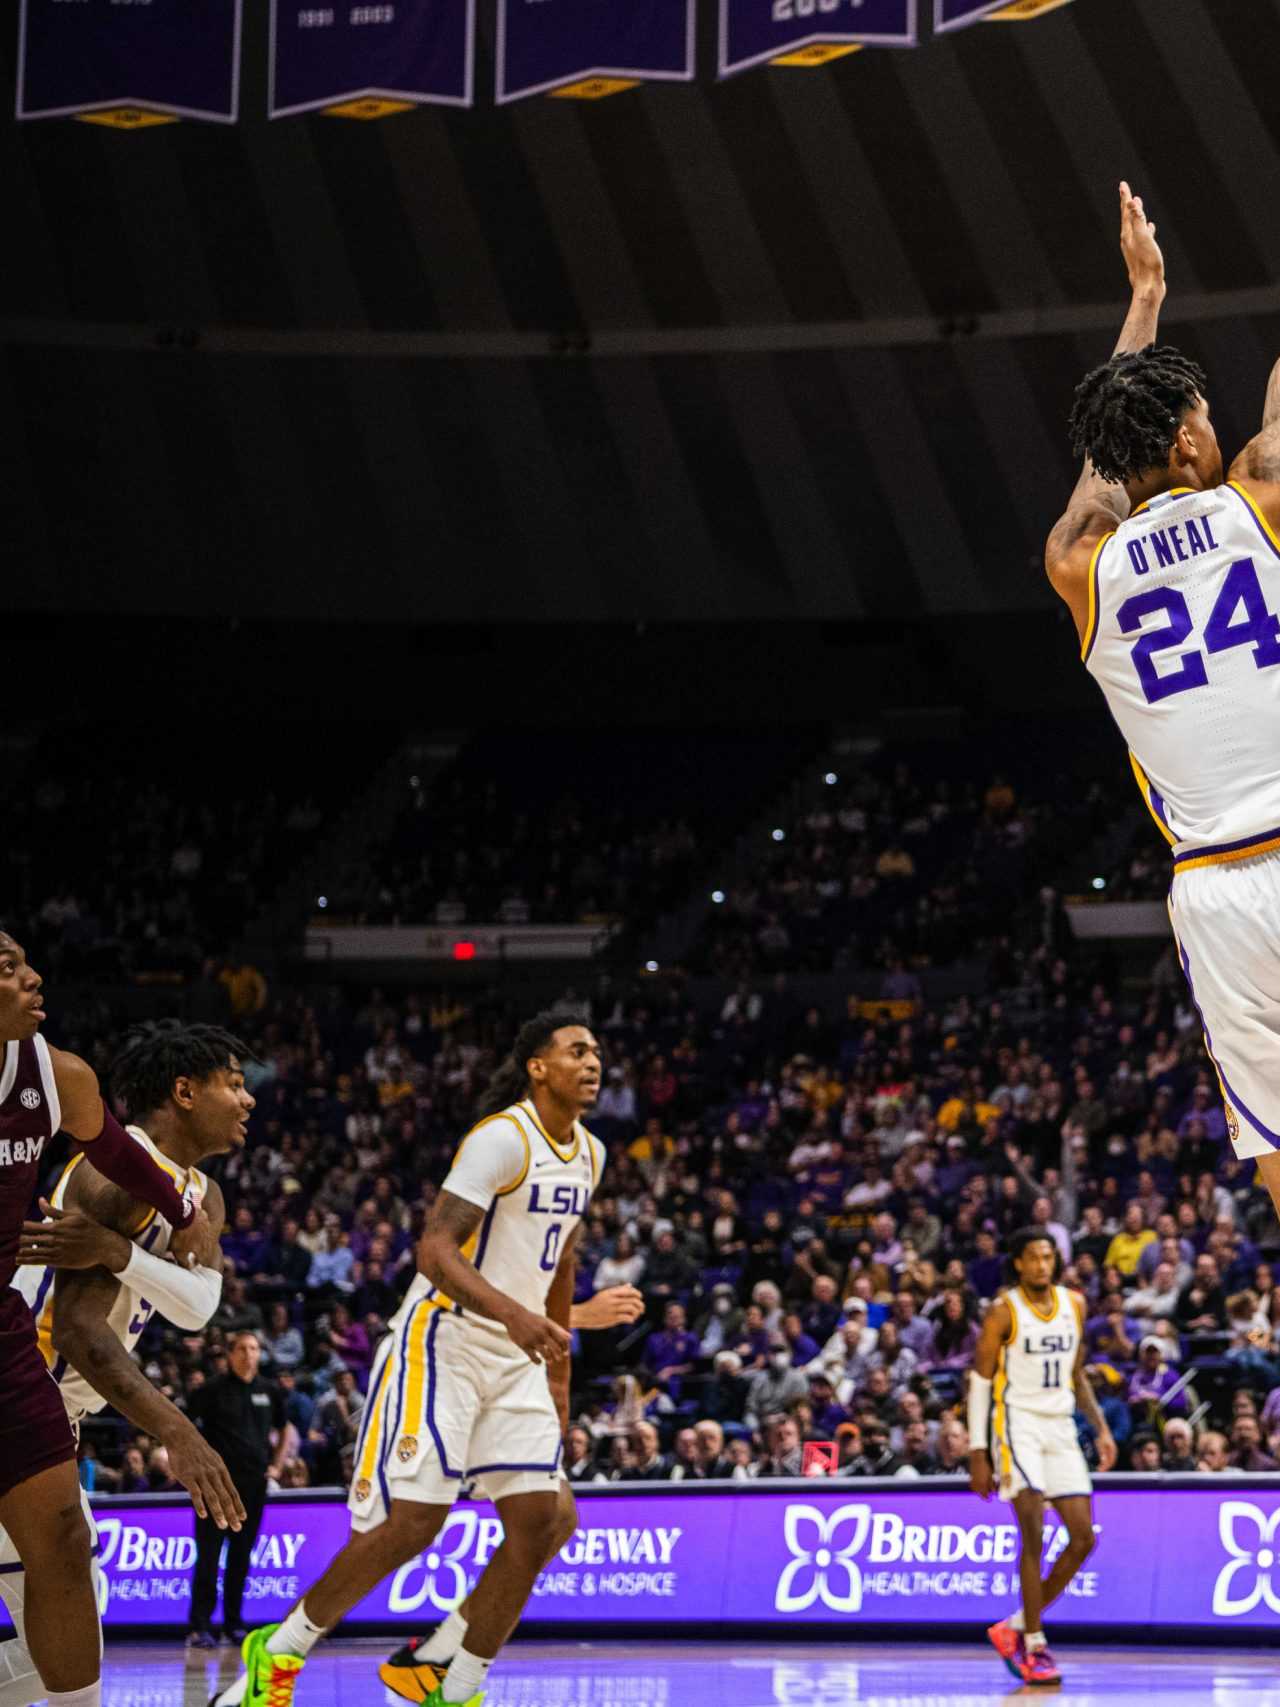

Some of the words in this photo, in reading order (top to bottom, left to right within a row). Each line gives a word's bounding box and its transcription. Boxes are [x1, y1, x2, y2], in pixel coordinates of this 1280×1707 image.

[1127, 515, 1219, 576] O'NEAL
[528, 1184, 589, 1216] LSU
[540, 1223, 562, 1272] 0
[1023, 1335, 1073, 1355] LSU
[1042, 1360, 1060, 1388] 11
[581, 1571, 597, 1597] &
[598, 1571, 679, 1597] HOSPICE
[862, 1571, 989, 1597] HEALTHCARE
[991, 1571, 1008, 1596] &
